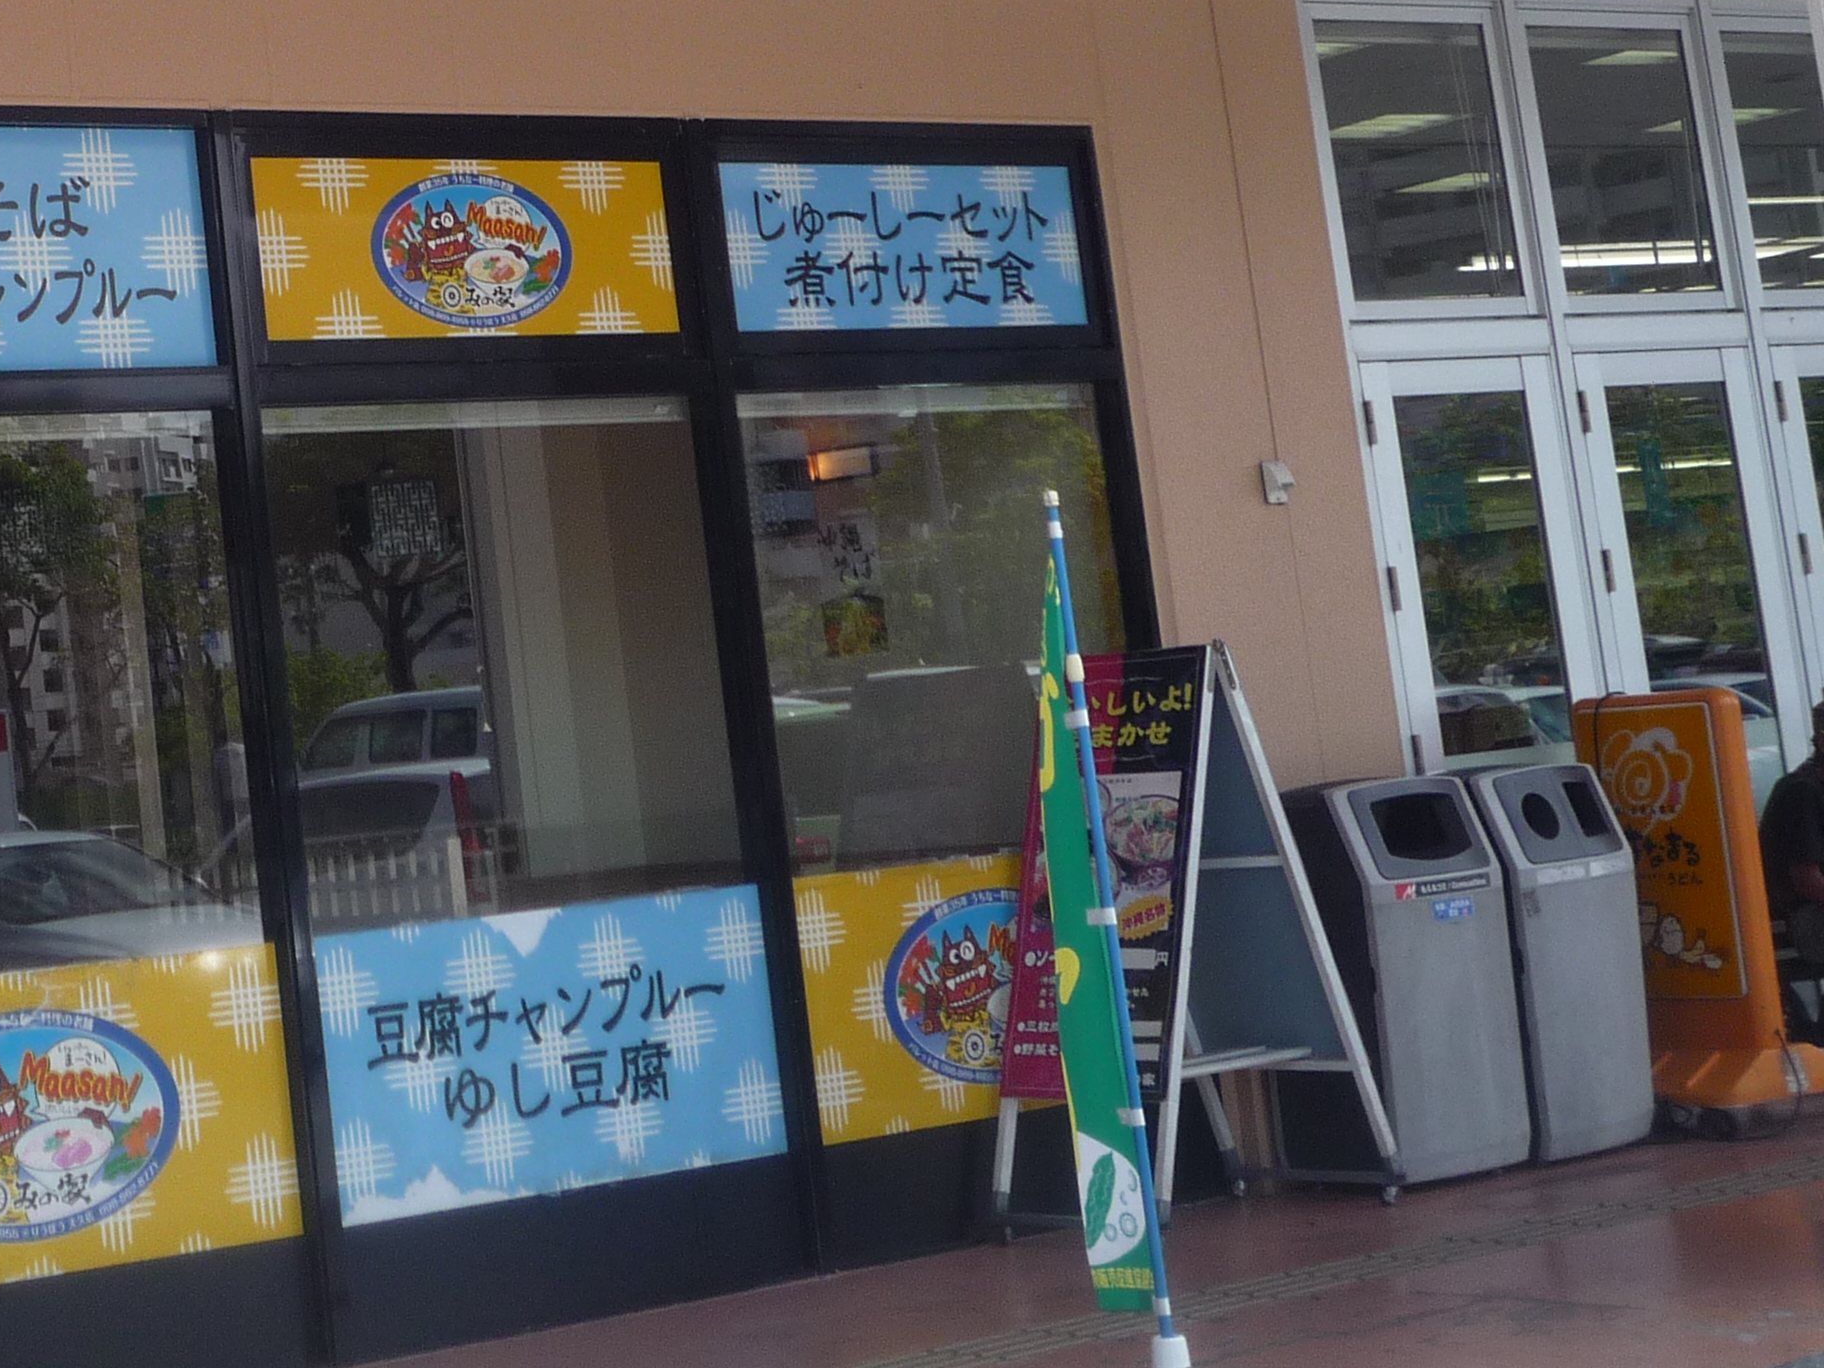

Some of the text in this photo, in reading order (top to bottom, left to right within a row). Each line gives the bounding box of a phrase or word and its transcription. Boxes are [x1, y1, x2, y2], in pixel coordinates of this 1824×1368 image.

[465, 199, 549, 252] Maasan!
[753, 190, 1049, 243] じゅーしーセット
[783, 249, 1037, 308] 煮付け定食
[366, 962, 726, 1070] 豆腐チャンプルー
[17, 1049, 144, 1113] Maasan!
[444, 1038, 673, 1129] ゆし豆腐
